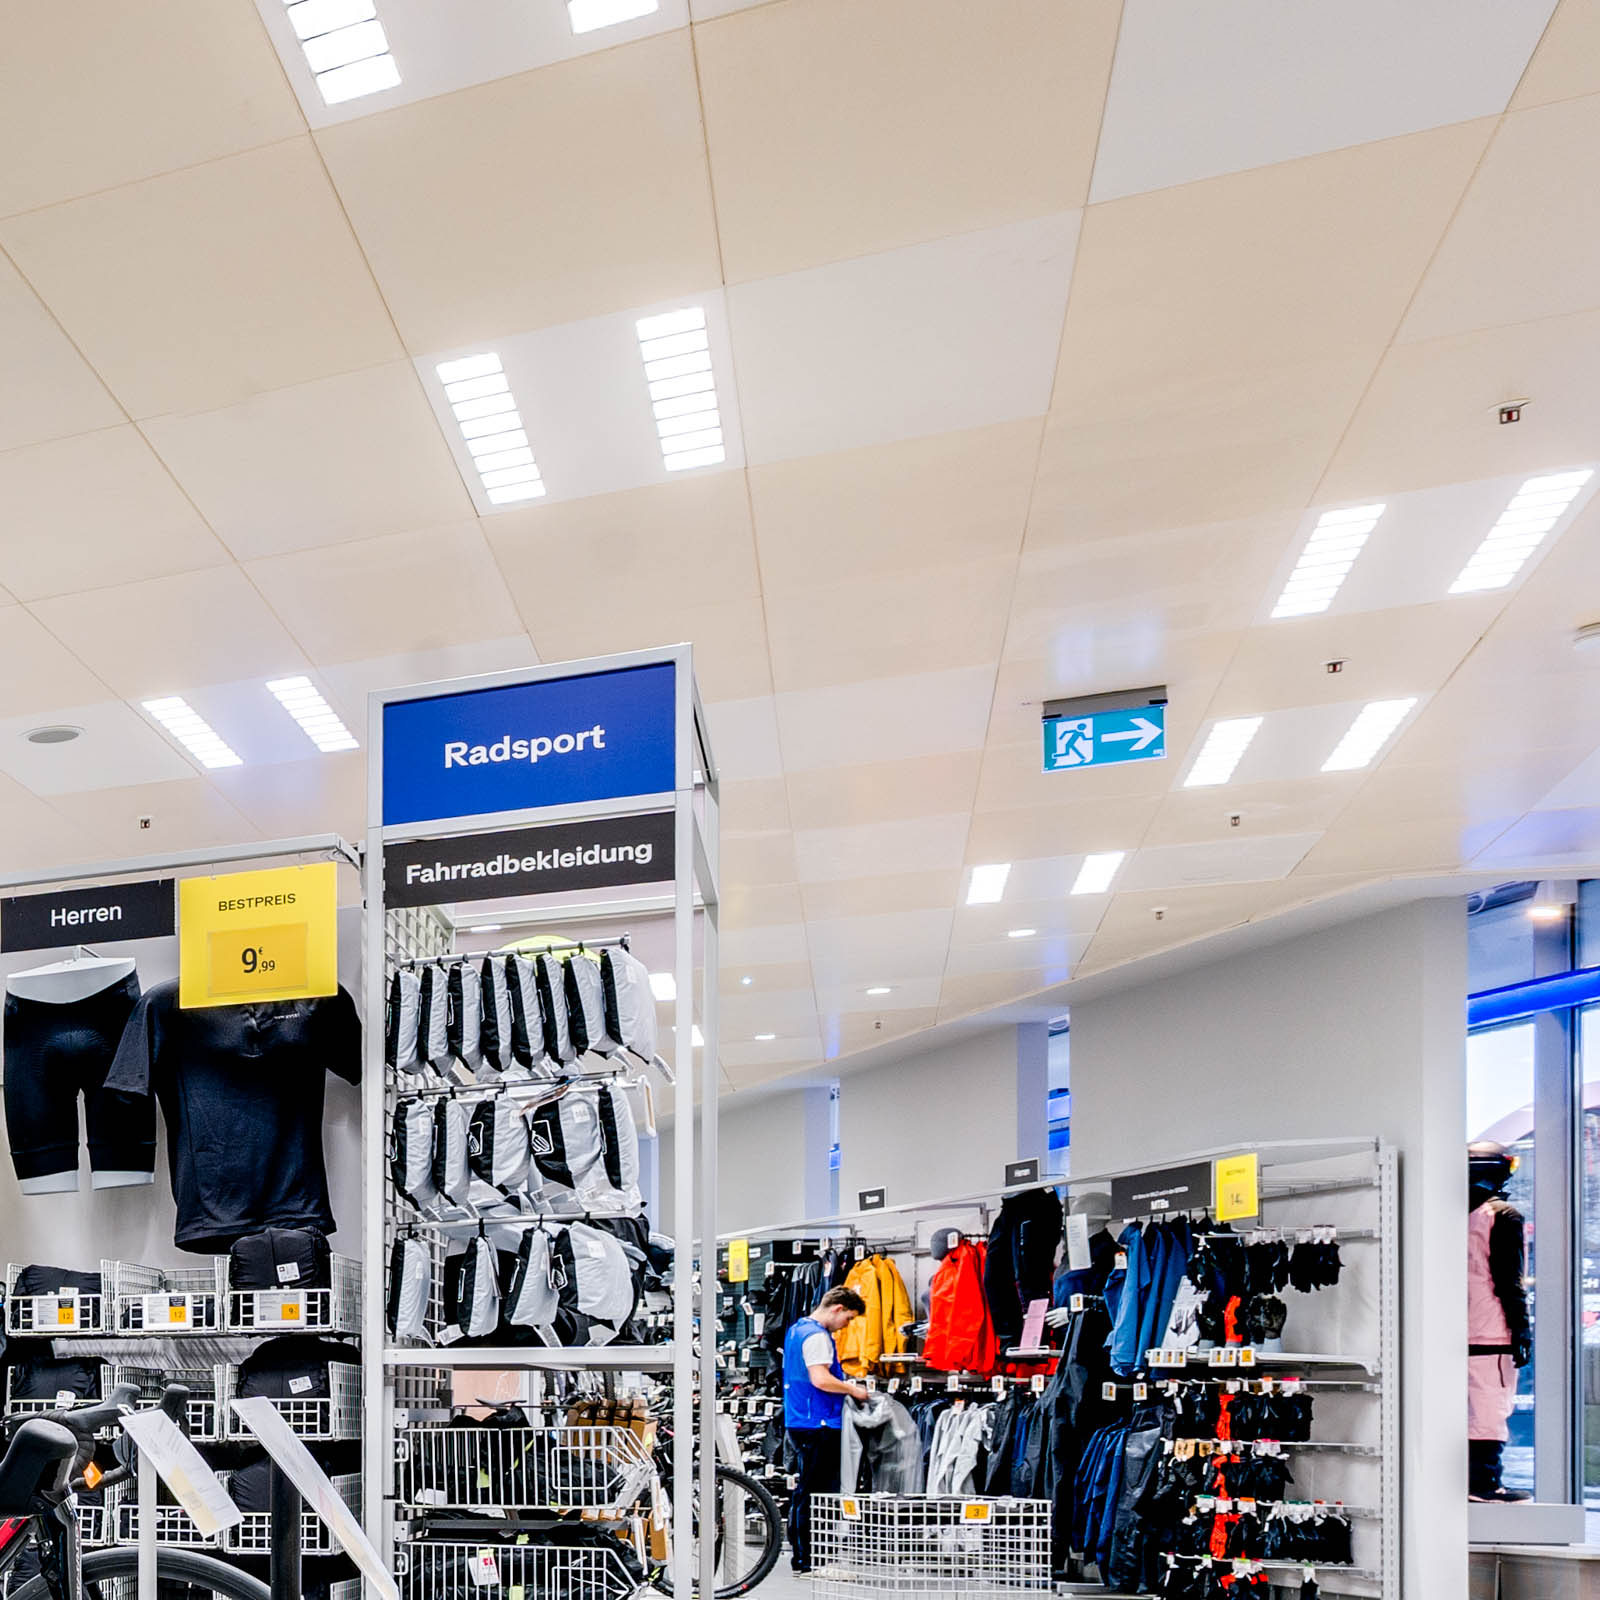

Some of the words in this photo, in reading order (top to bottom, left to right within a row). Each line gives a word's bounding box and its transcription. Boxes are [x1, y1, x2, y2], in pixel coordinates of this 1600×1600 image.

[444, 724, 606, 768] Radsport
[406, 843, 653, 885] Fahrradbekleidung
[50, 904, 122, 928] Herren
[218, 893, 297, 912] BESTPREIS
